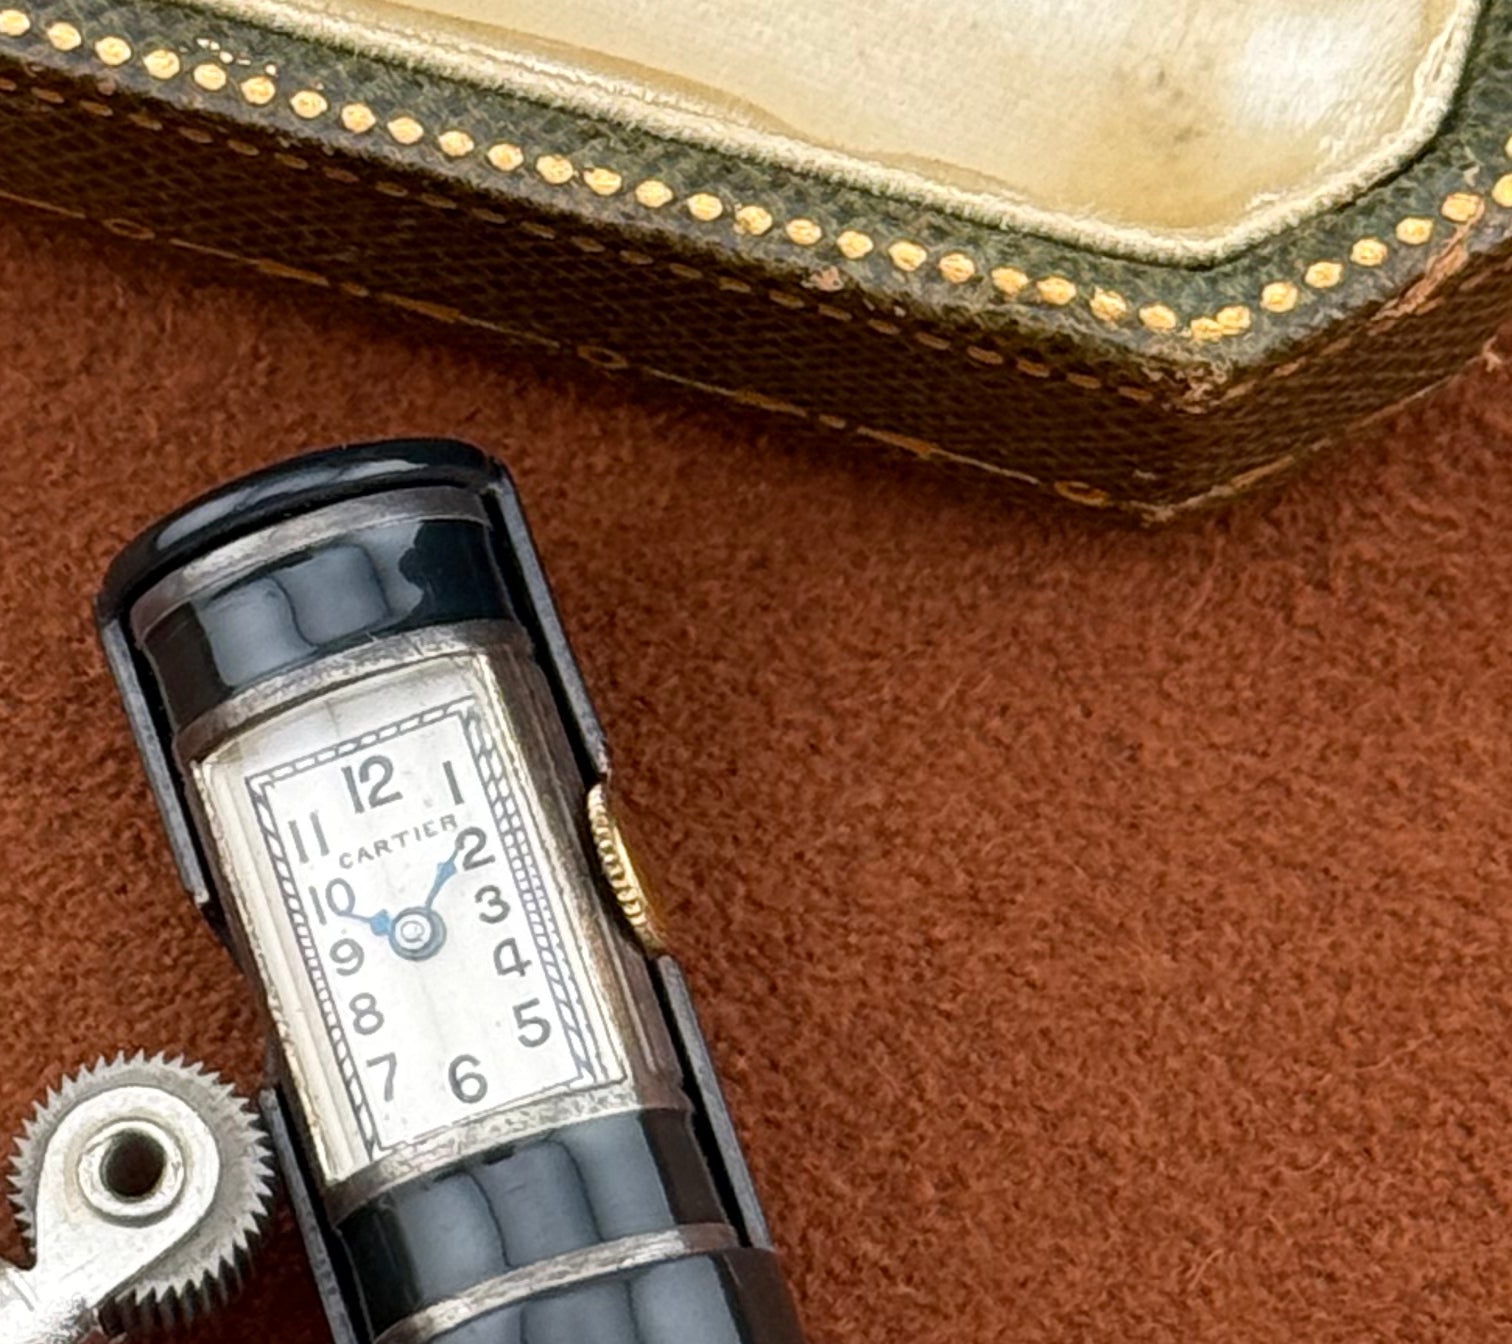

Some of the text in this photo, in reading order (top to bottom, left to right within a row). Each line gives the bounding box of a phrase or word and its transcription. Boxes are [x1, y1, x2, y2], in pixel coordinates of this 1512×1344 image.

[341, 755, 403, 813] 12
[443, 760, 464, 805] 1
[288, 811, 329, 864] 11
[338, 813, 458, 869] CARTIER
[454, 826, 496, 871] 2
[308, 877, 356, 925] 10
[474, 884, 510, 924] 3
[329, 938, 364, 976] 9
[493, 937, 532, 977] 4
[349, 992, 385, 1035] 8
[512, 997, 551, 1047] 5
[366, 1052, 397, 1102] 7
[448, 1053, 488, 1104] 6
